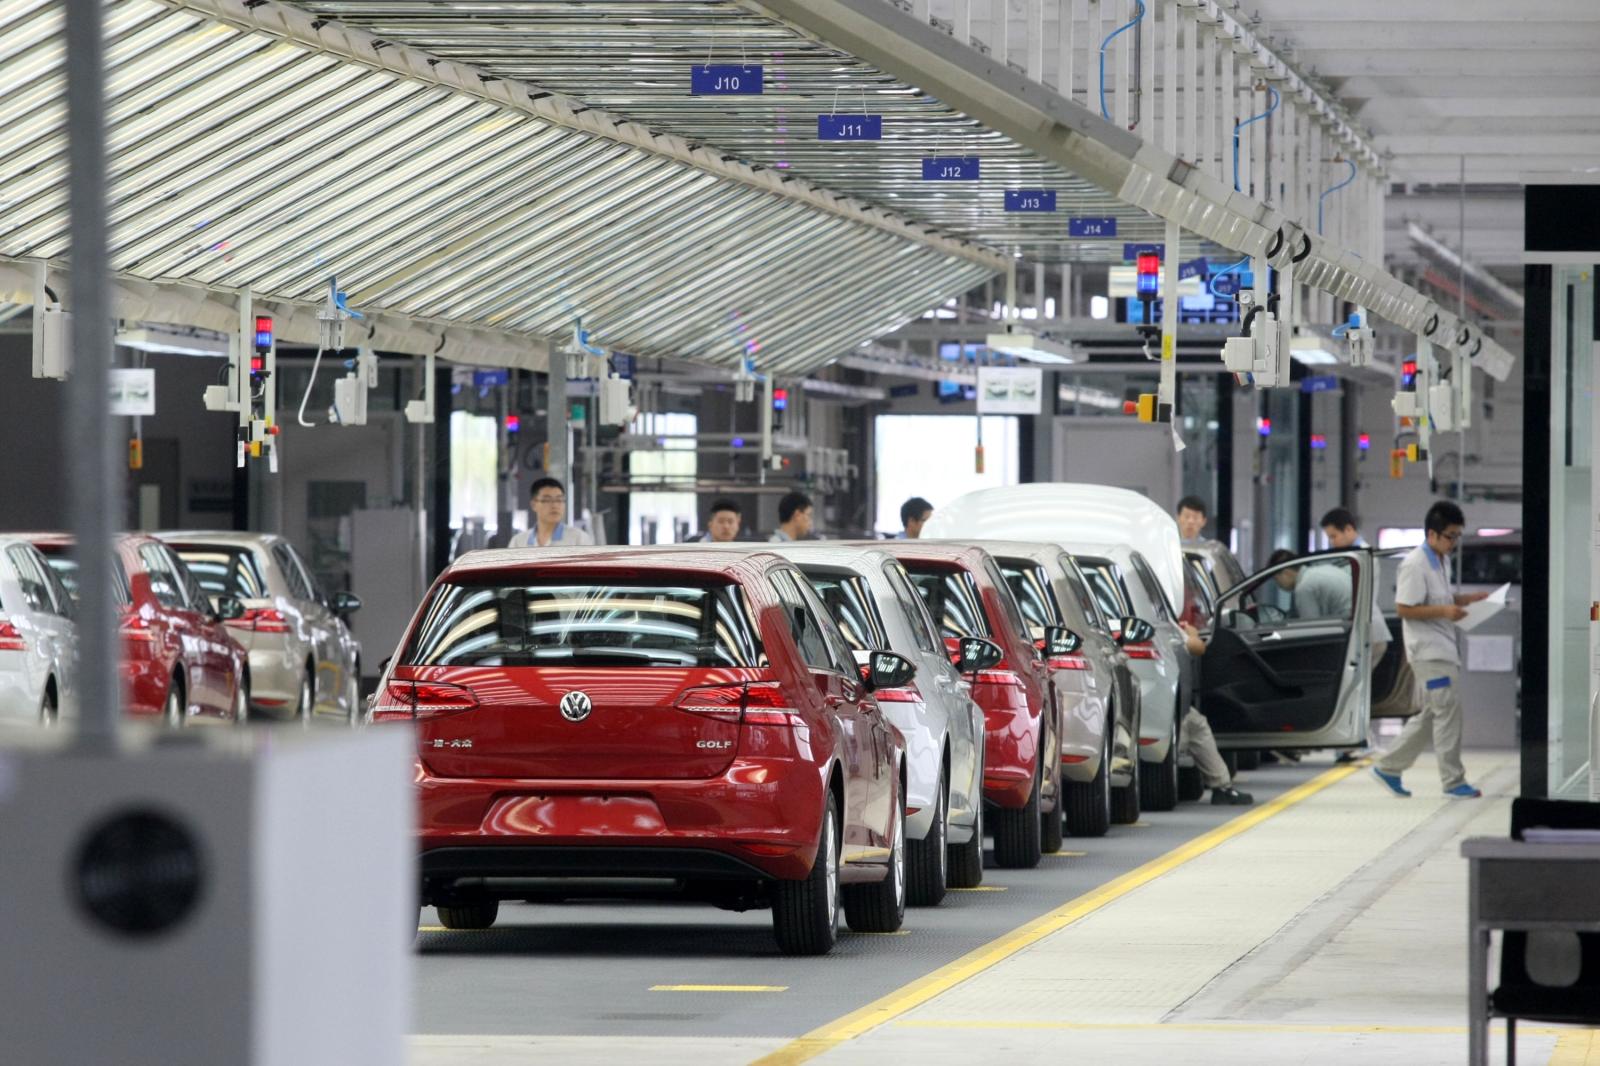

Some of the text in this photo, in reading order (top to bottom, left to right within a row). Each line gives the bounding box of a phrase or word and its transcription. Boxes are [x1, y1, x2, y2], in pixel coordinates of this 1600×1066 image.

[714, 76, 740, 91] J10
[839, 124, 862, 137] J11
[940, 166, 961, 178] J12
[1020, 198, 1040, 209] J13
[1083, 224, 1102, 235] J14
[560, 690, 592, 722] VW
[696, 740, 732, 749] GOLF
